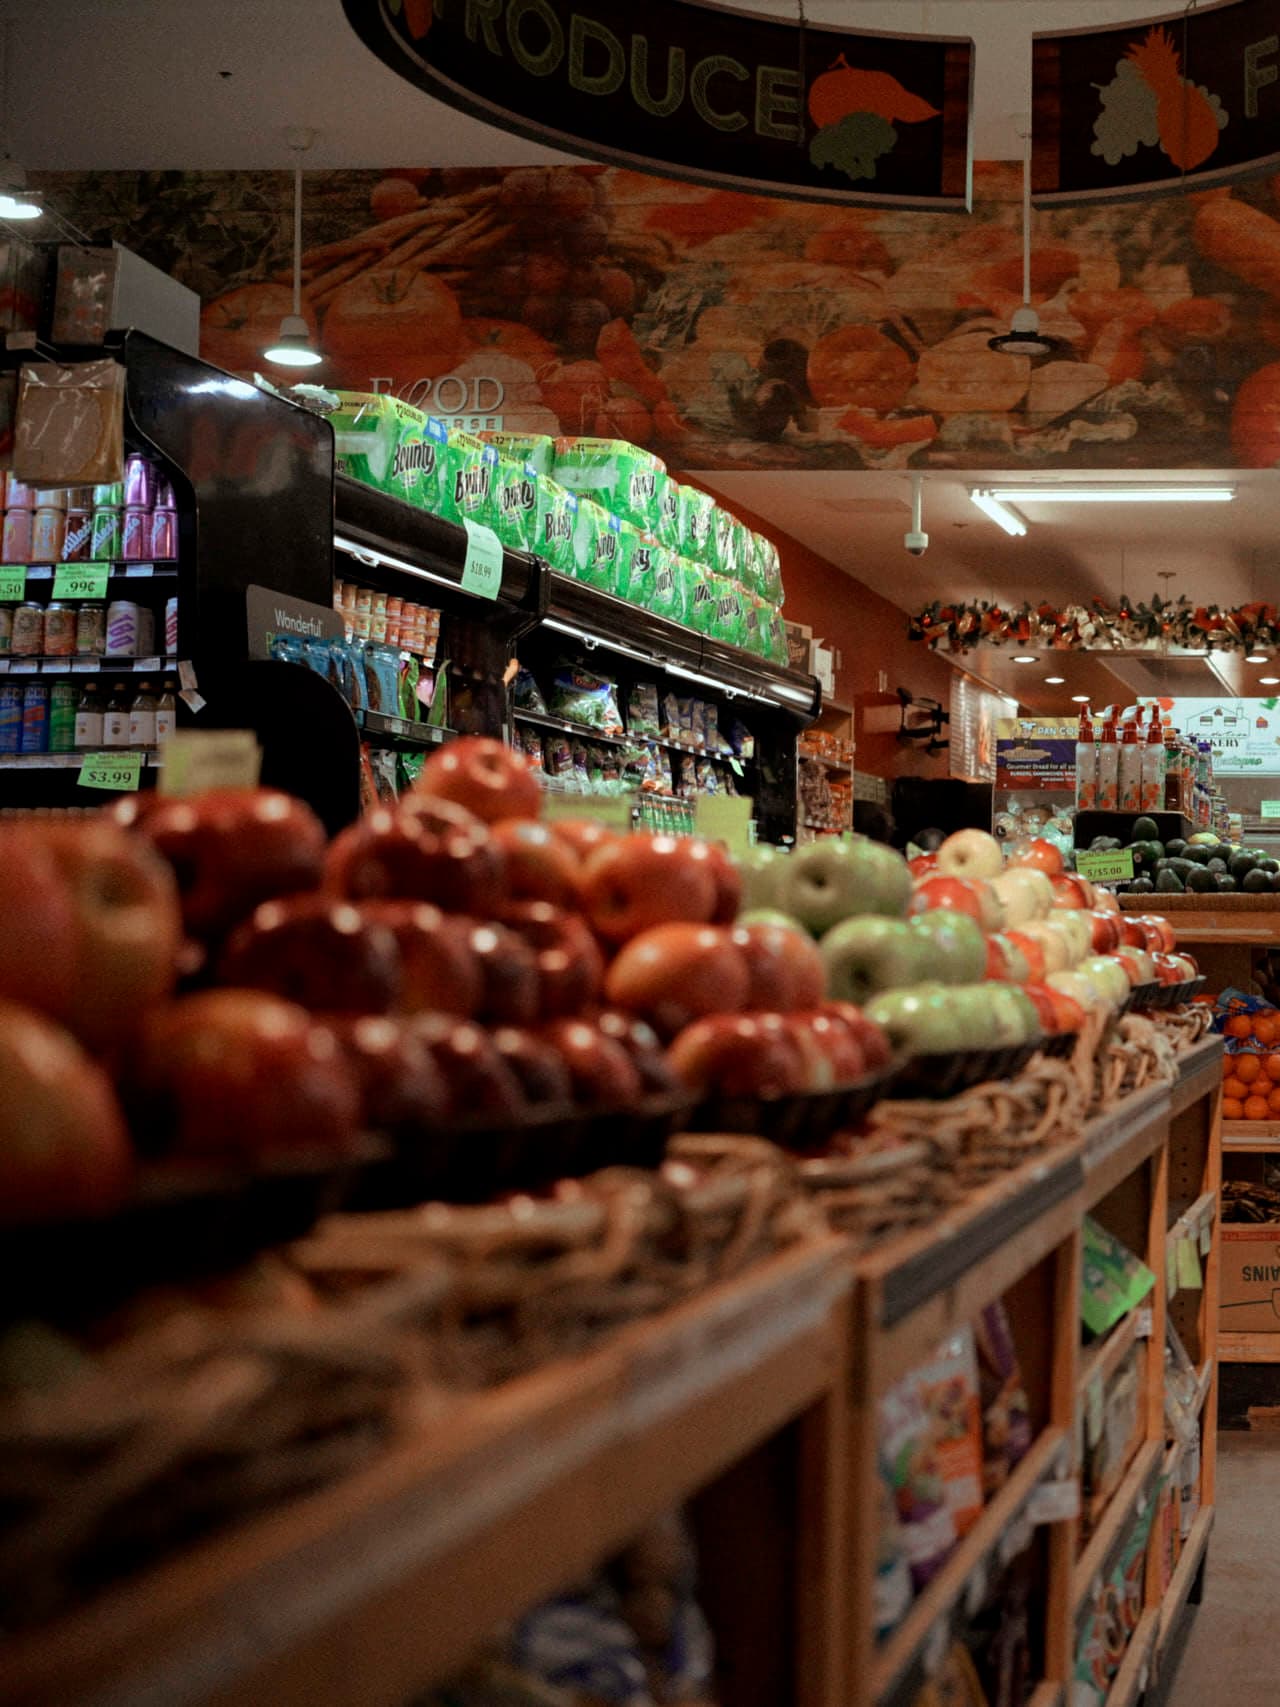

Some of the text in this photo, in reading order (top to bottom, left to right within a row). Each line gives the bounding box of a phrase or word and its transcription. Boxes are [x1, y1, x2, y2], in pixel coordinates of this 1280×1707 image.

[434, 0, 806, 142] RODUCE
[0, 582, 21, 595] .50
[274, 608, 322, 638] Wonderful
[88, 770, 132, 784] $3.99
